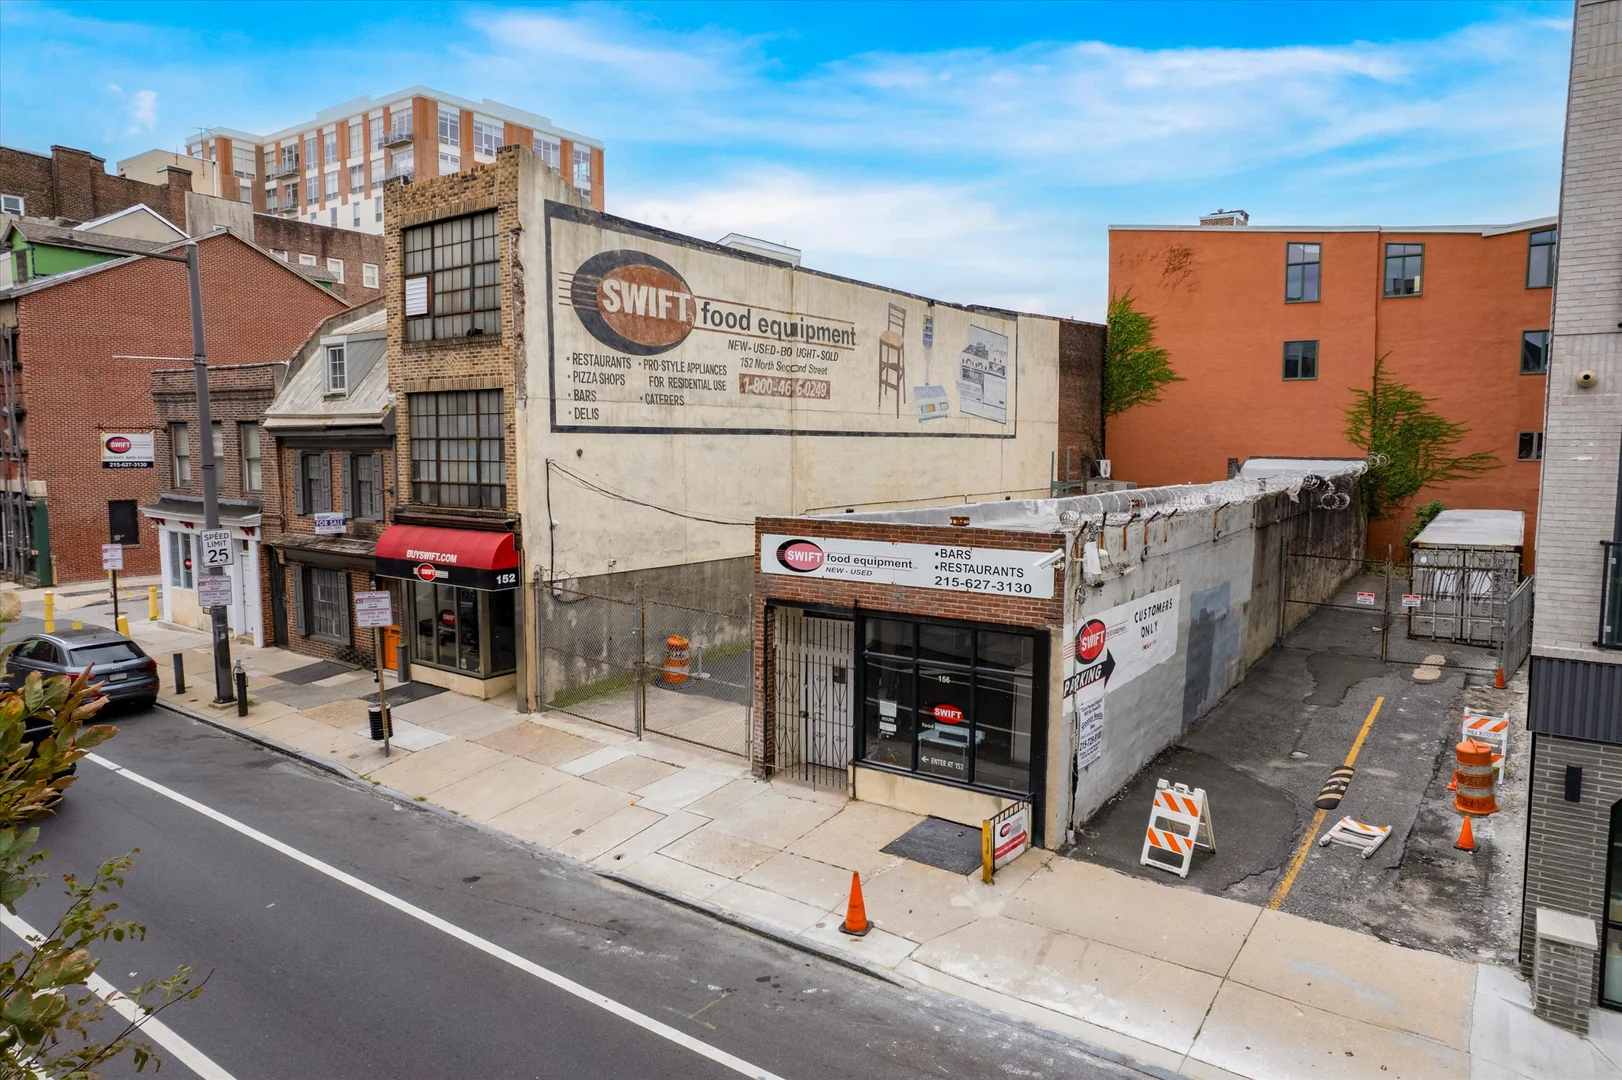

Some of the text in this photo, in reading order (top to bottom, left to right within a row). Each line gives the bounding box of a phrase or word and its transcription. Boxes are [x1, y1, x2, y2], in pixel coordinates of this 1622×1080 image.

[602, 279, 856, 346] SWIFT food equipment
[572, 352, 631, 369] RESTAURANTS
[644, 359, 727, 376] PRO-STYLE APPLIANCES
[740, 357, 828, 375] 152 North Second Street
[573, 370, 626, 386] PIZZA SHOPS
[649, 376, 726, 391] FOR RESIDENTIAL USE
[574, 389, 597, 402] BARS
[645, 393, 685, 406] CATERERS
[574, 407, 599, 420] DELIS
[208, 549, 228, 563] 25
[406, 550, 457, 563] BUYSWIFT.COM
[787, 550, 913, 569] SWIFT food equipment
[940, 548, 971, 560] BARS
[850, 568, 873, 576] USED
[940, 562, 1024, 578] RESTAURANTS
[496, 573, 516, 584] 152
[935, 576, 1032, 594] 215-627-3130
[1134, 598, 1172, 623] CUSTOMERS
[1141, 620, 1158, 638] ONLY
[1082, 630, 1105, 652] SWIFT
[1064, 664, 1102, 697] PARKING
[934, 708, 962, 719] SWIFT
[931, 758, 947, 767] ENTER
